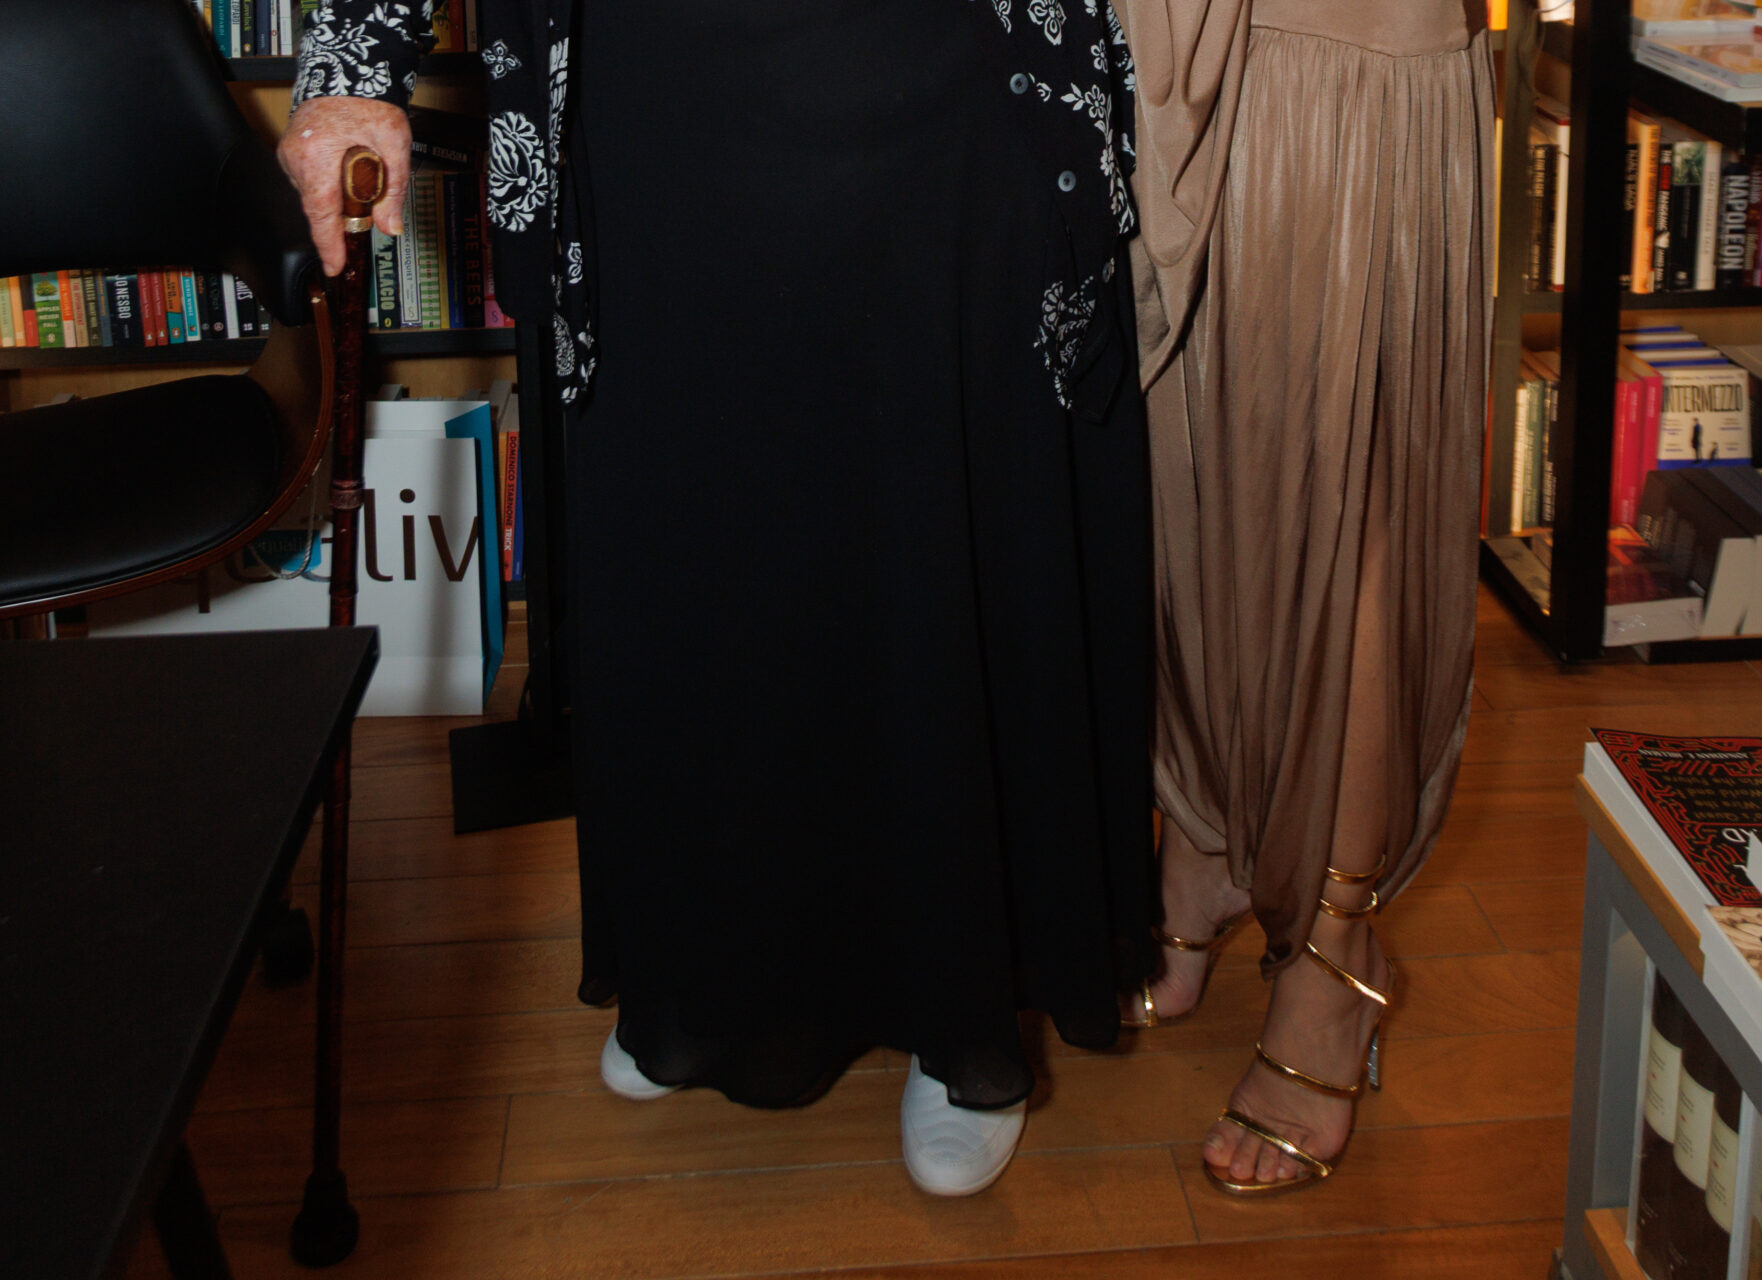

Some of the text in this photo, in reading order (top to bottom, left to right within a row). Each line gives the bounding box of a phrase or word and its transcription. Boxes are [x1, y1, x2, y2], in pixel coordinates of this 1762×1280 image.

[243, 0, 251, 32] Lovelock
[1657, 190, 1670, 231] PANDEMIC
[1720, 175, 1749, 270] NAPOLEON
[378, 251, 395, 310] PALACIO
[404, 248, 413, 281] DISQUIET
[464, 215, 482, 305] THE BEES
[1662, 384, 1743, 413] INTERMEZZO
[503, 435, 517, 551] DOMENICO STARNONE TRICK
